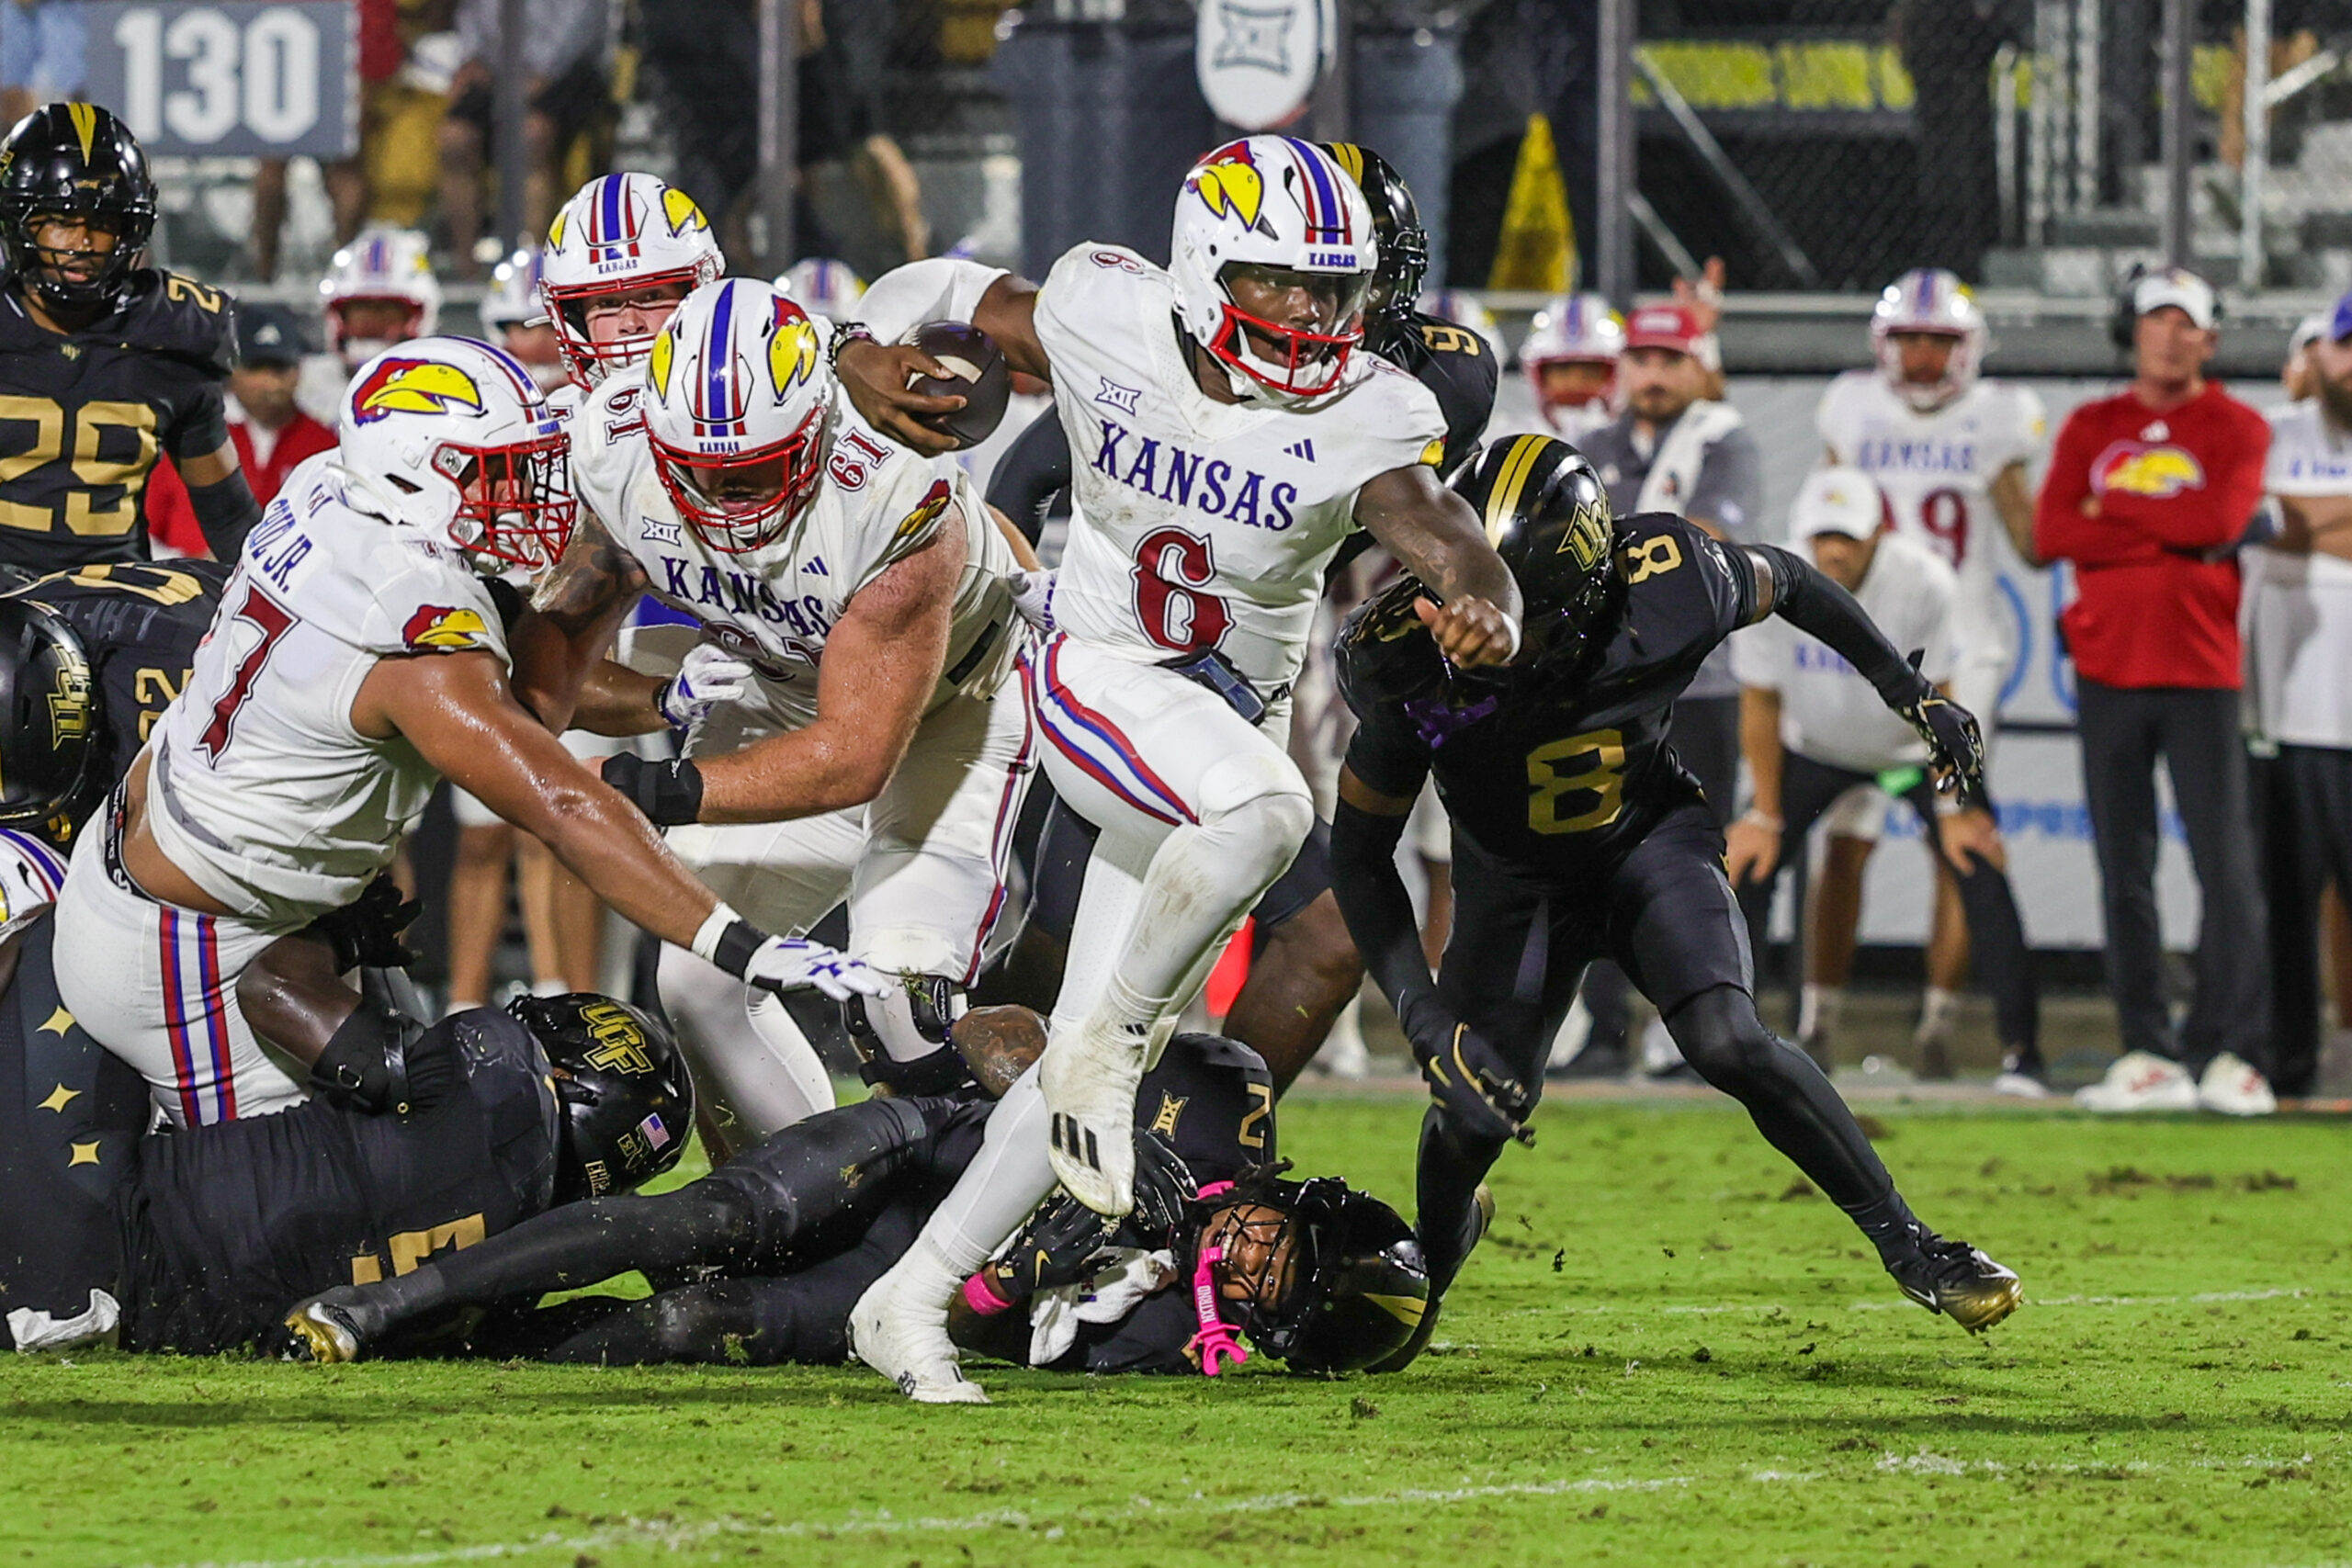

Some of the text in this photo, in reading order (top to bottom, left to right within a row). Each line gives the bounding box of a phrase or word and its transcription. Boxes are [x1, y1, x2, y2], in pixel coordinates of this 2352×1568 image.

[114, 6, 321, 143] 130
[598, 259, 639, 276] KANSAS
[1309, 253, 1356, 267] KANSAS
[0, 394, 157, 536] 29
[699, 441, 741, 454] KANSAS
[826, 426, 895, 492] 61
[1091, 420, 1297, 532] KANSAS
[262, 533, 314, 594] JR.
[1128, 525, 1237, 655] 6
[1616, 533, 1684, 586] 8
[660, 555, 832, 637] KANSAS
[1526, 728, 1625, 836] 8
[579, 1000, 655, 1075] UCF
[1238, 1082, 1272, 1148] 2
[1196, 1284, 1216, 1324] NXTRND
